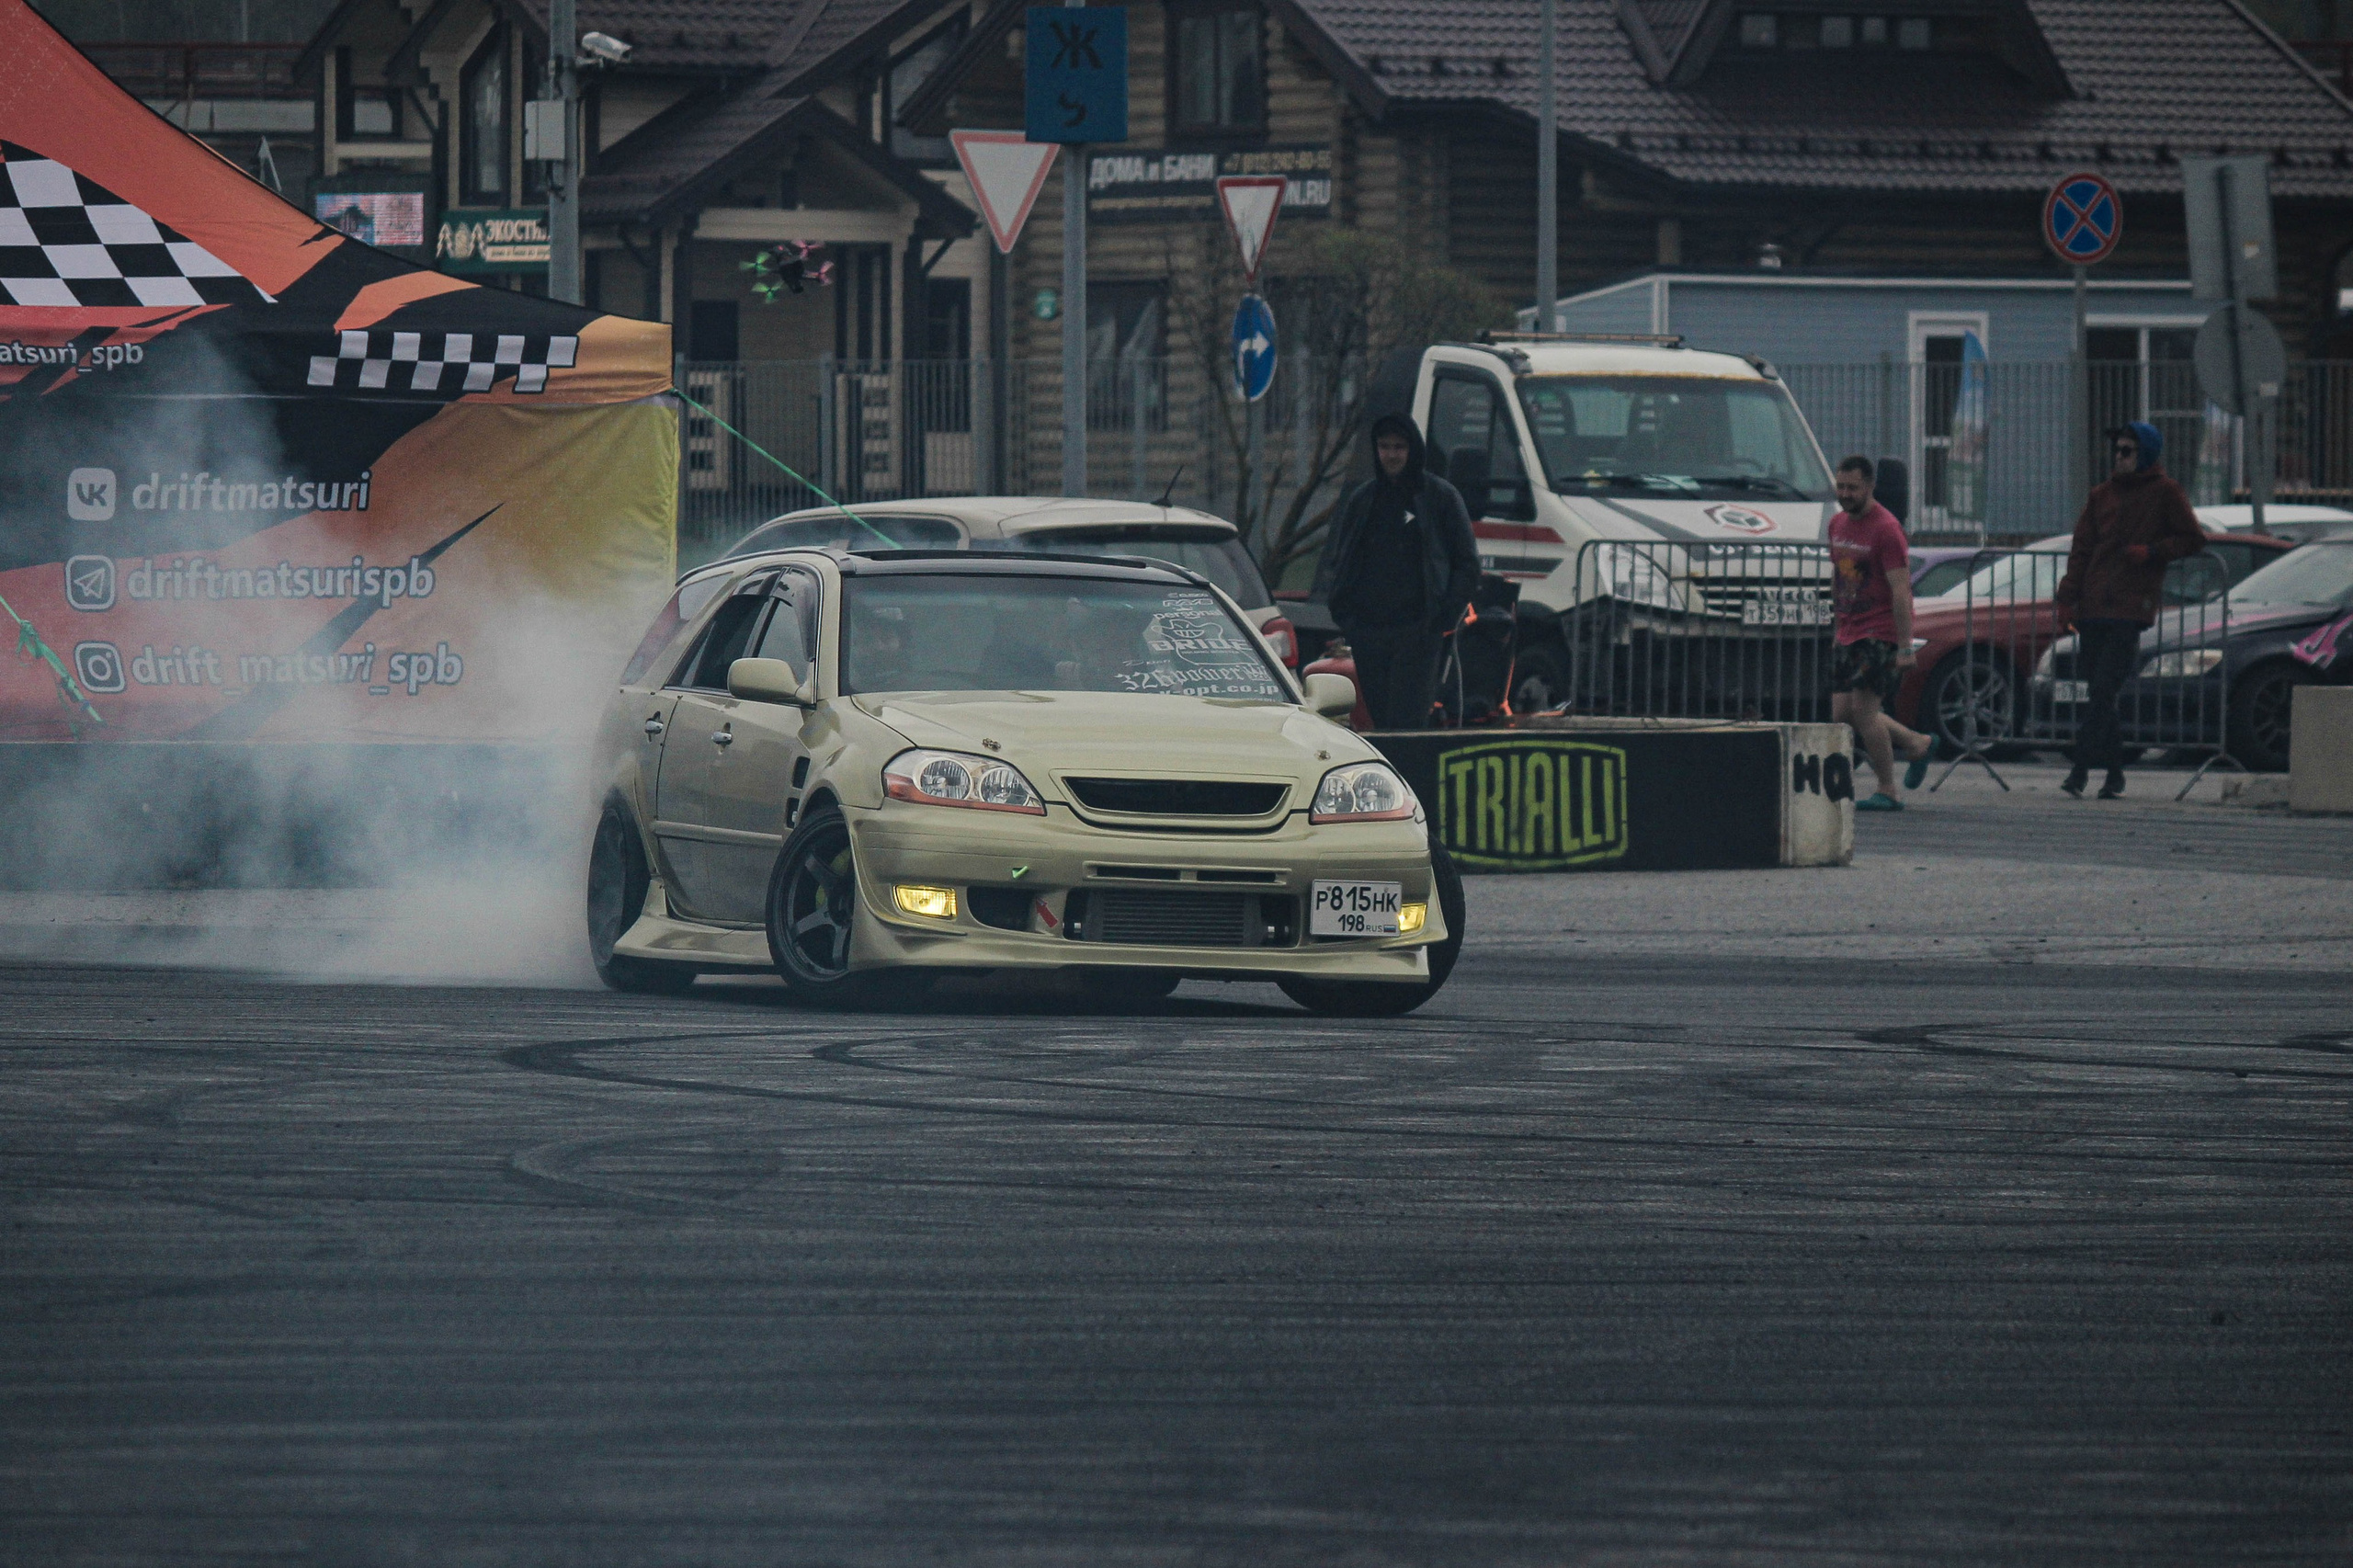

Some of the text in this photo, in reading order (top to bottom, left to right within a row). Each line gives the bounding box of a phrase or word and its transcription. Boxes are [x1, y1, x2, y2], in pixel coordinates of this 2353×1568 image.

[1089, 156, 1145, 188] ДОМА
[1164, 154, 1214, 180] БАНИ
[131, 472, 369, 511] driftmatsuri
[127, 557, 434, 608] driftmatsurispb
[1147, 638, 1254, 651] BRIDE
[131, 642, 461, 695] drift_matsuri_spb
[1449, 752, 1615, 854] TRIALLI
[1338, 914, 1365, 932] 198
